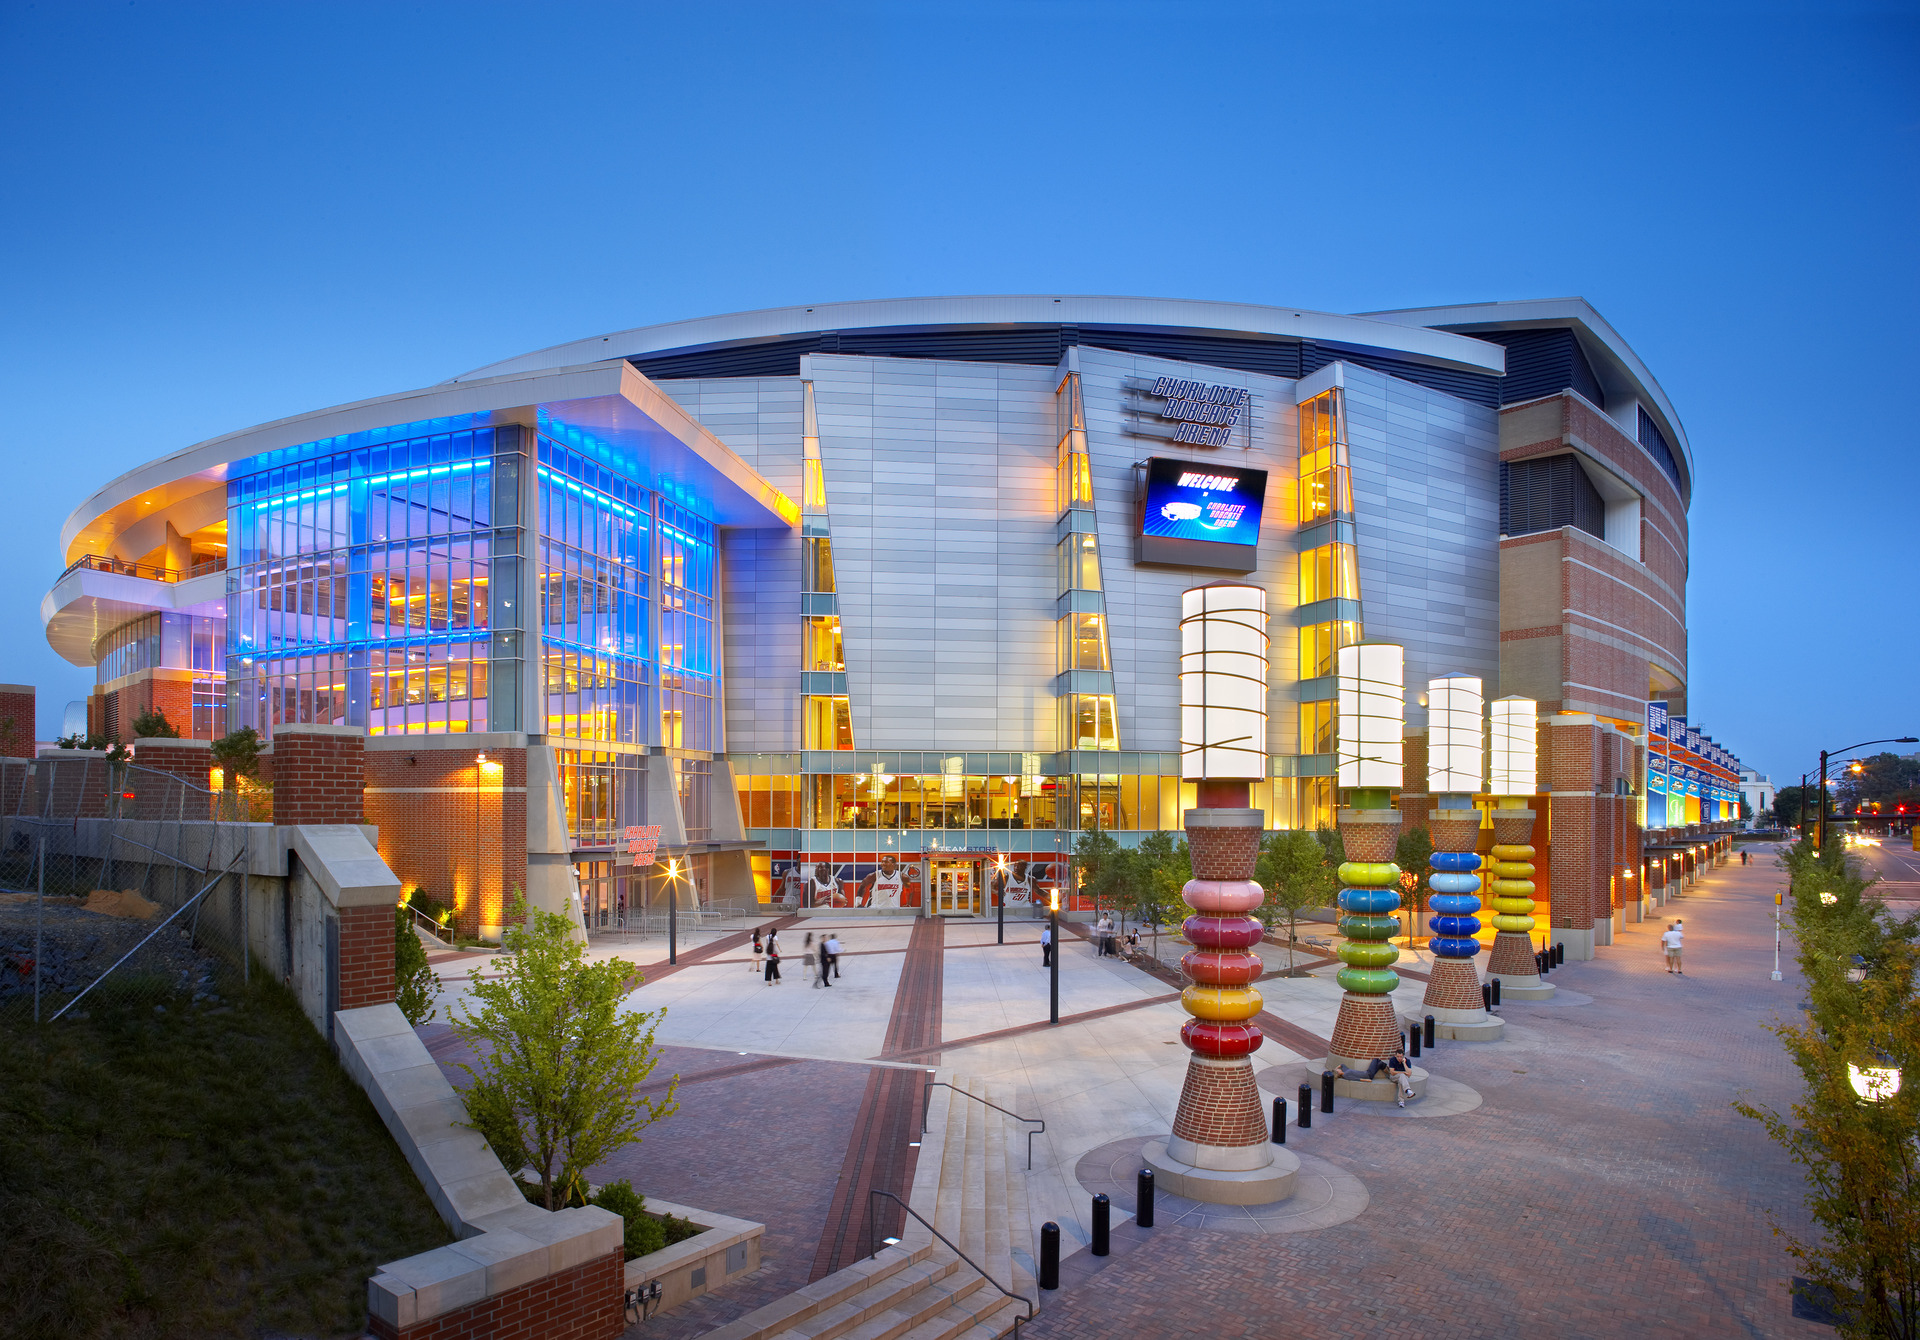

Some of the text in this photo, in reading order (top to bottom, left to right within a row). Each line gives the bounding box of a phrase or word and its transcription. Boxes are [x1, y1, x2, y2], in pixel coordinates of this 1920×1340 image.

[1151, 376, 1249, 407] CHARLOTTE
[1162, 397, 1242, 427] BOBCATS
[1173, 421, 1232, 447] ARENA
[1177, 472, 1239, 492] WELCOME
[1206, 501, 1246, 514] CHARLOTTE
[1209, 510, 1242, 520] BOBCATS
[623, 825, 661, 839] CHARLOTTE
[627, 839, 658, 853] BOBCATS
[633, 852, 656, 867] ARENA
